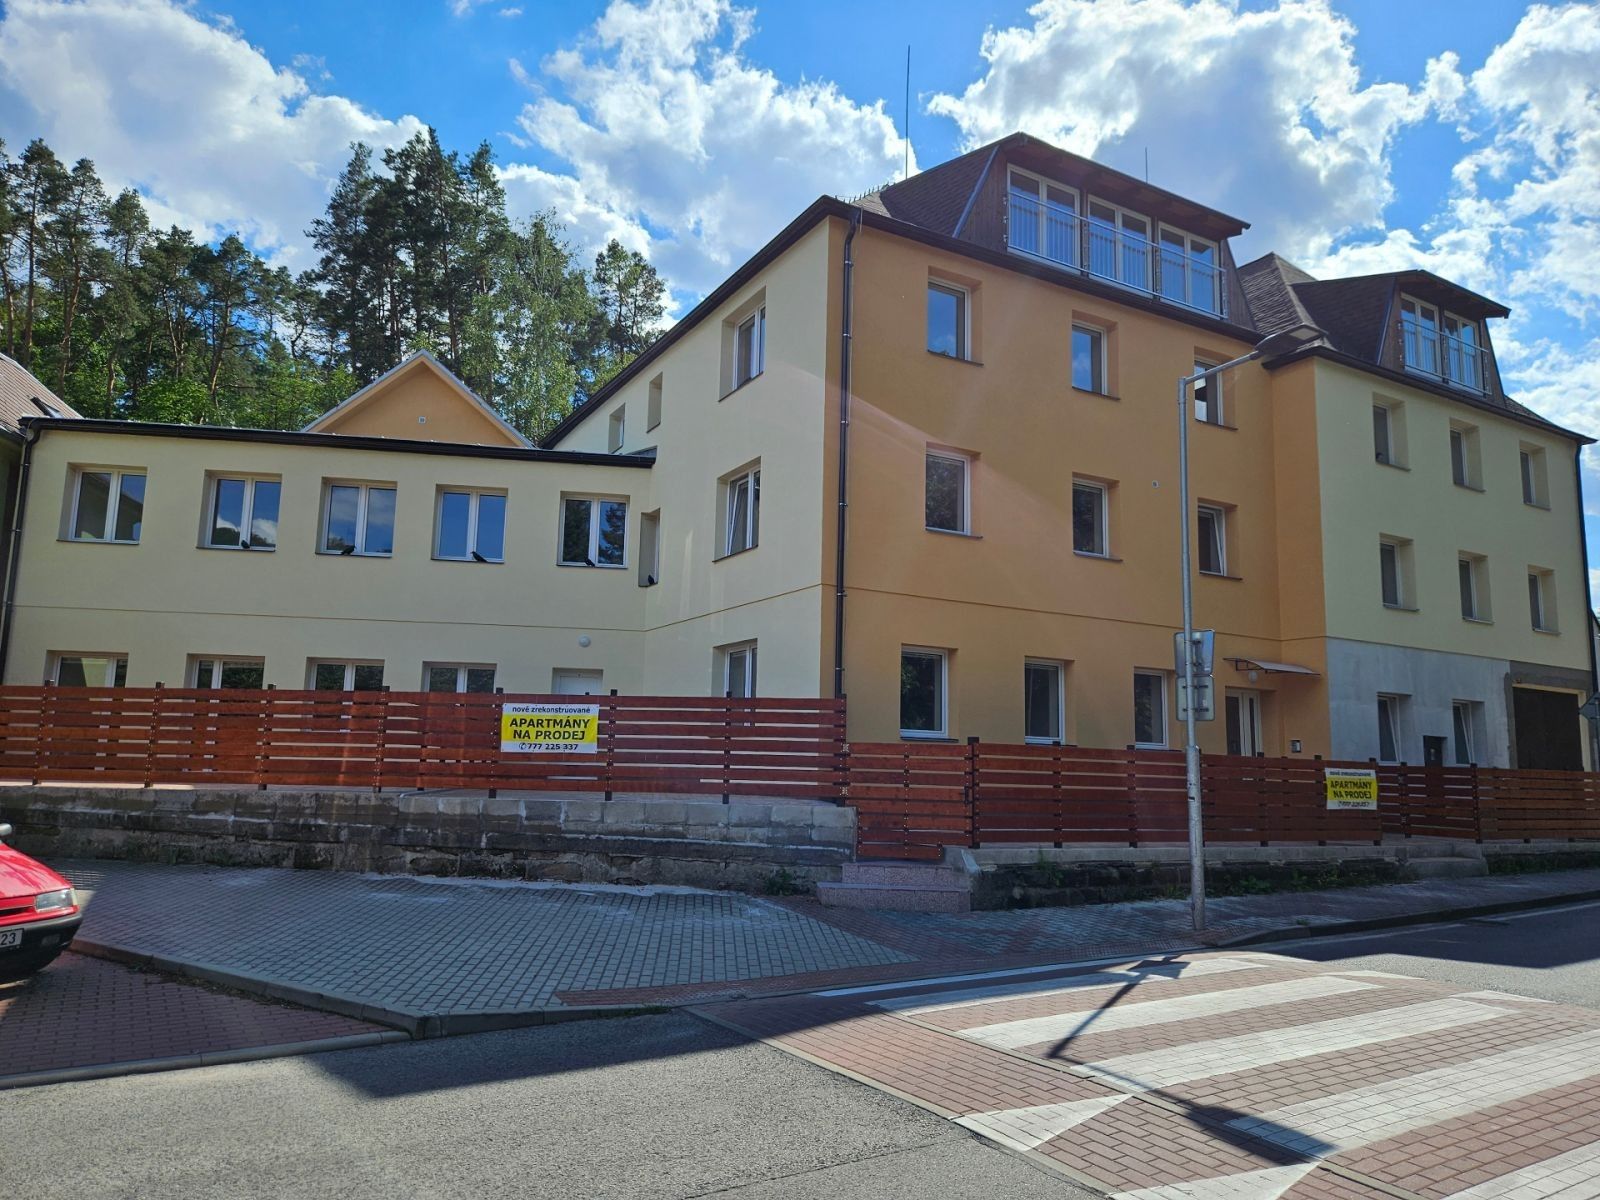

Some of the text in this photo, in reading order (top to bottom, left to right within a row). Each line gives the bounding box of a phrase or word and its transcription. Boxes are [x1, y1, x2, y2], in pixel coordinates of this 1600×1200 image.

[509, 716, 591, 729] APARTMÁNY
[513, 730, 585, 741] NA PRODEJ
[563, 743, 579, 751] 337
[1333, 790, 1372, 799] NA PRODEJ
